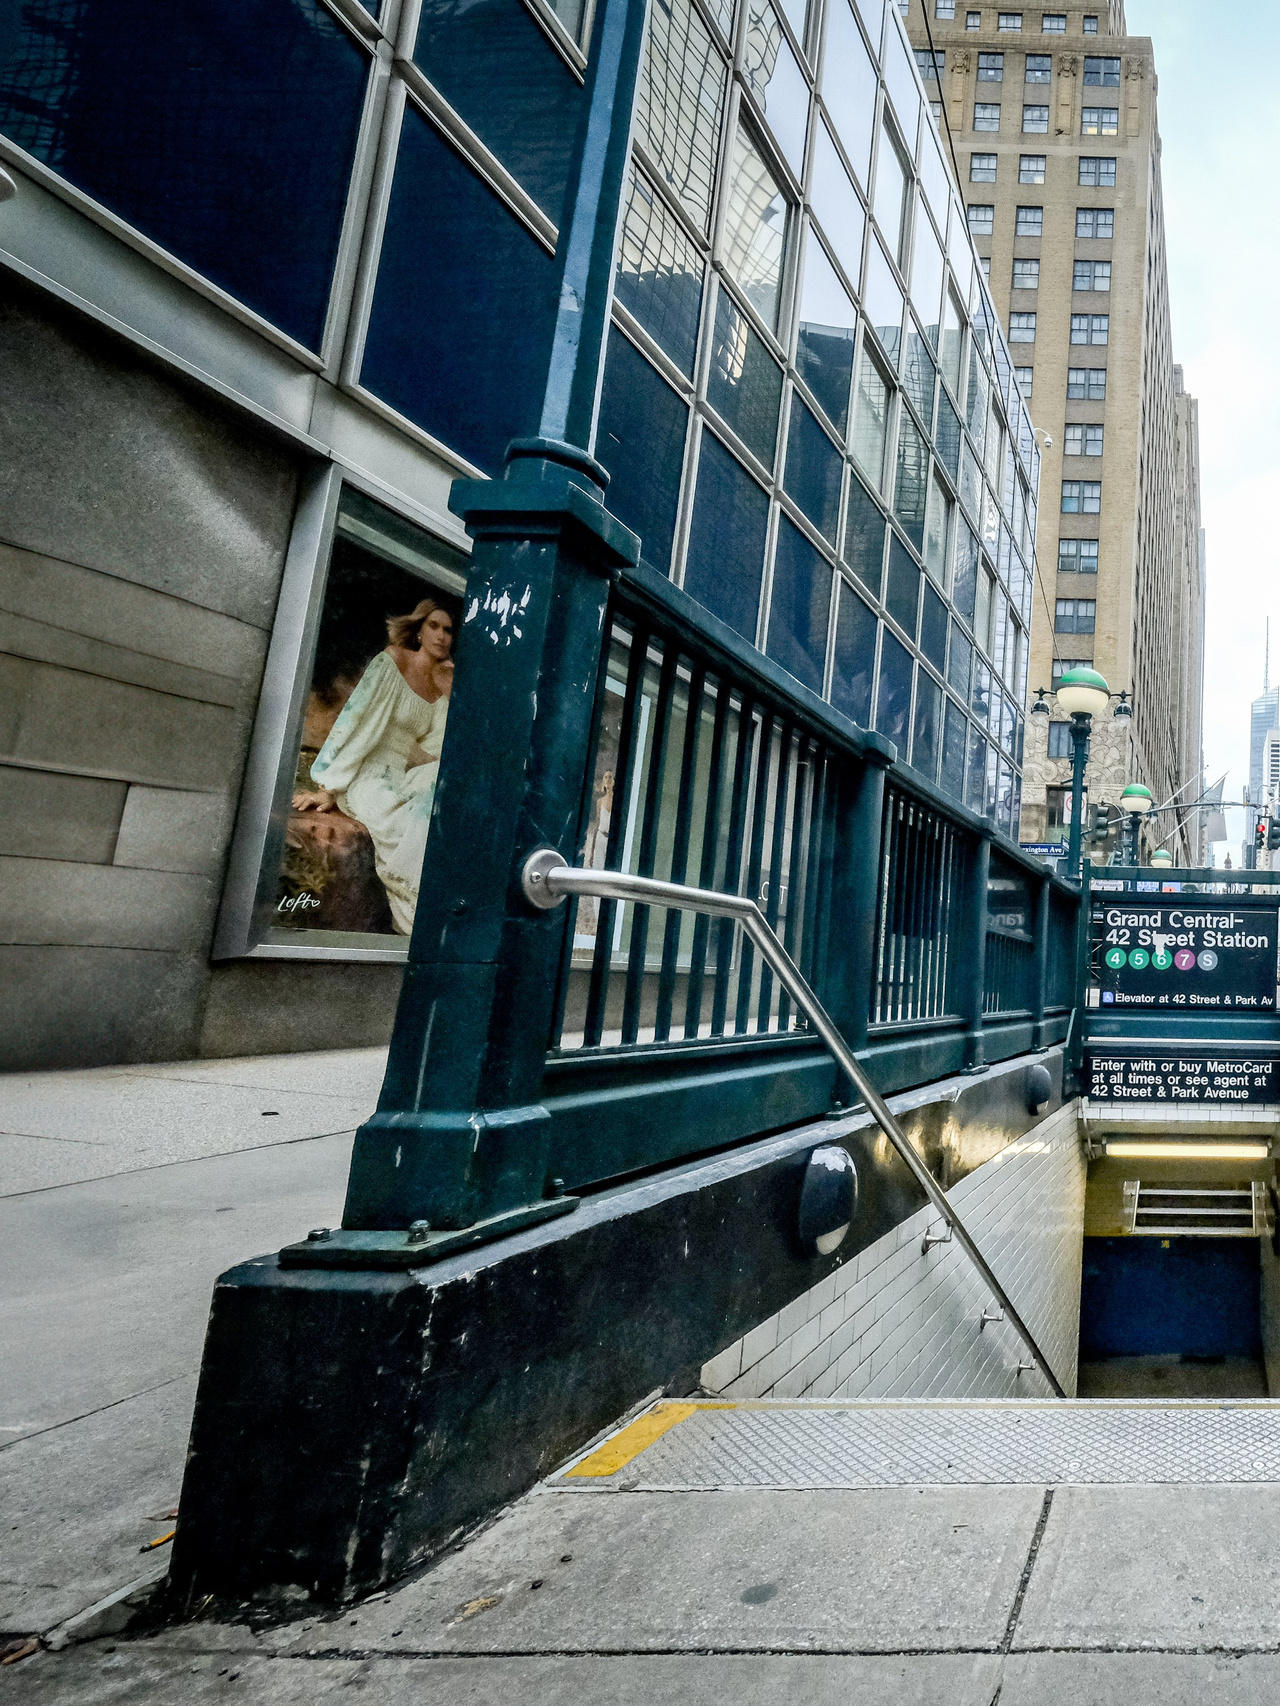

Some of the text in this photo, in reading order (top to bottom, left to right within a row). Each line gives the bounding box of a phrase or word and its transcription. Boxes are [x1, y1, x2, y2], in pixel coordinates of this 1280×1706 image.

[1021, 846, 1048, 854] xington
[1107, 909, 1243, 929] Grand Central-
[1106, 928, 1269, 948] 42 Steet Station
[1110, 952, 1213, 967] 4 5 6 7 S
[1115, 992, 1273, 1005] Elevator at 42 Street & Park Av
[1092, 1059, 1272, 1074] Enter with or buy MetroCard
[1091, 1073, 1267, 1088] at all times or see agent at
[1091, 1085, 1249, 1099] 42 Street & Park Avenue
